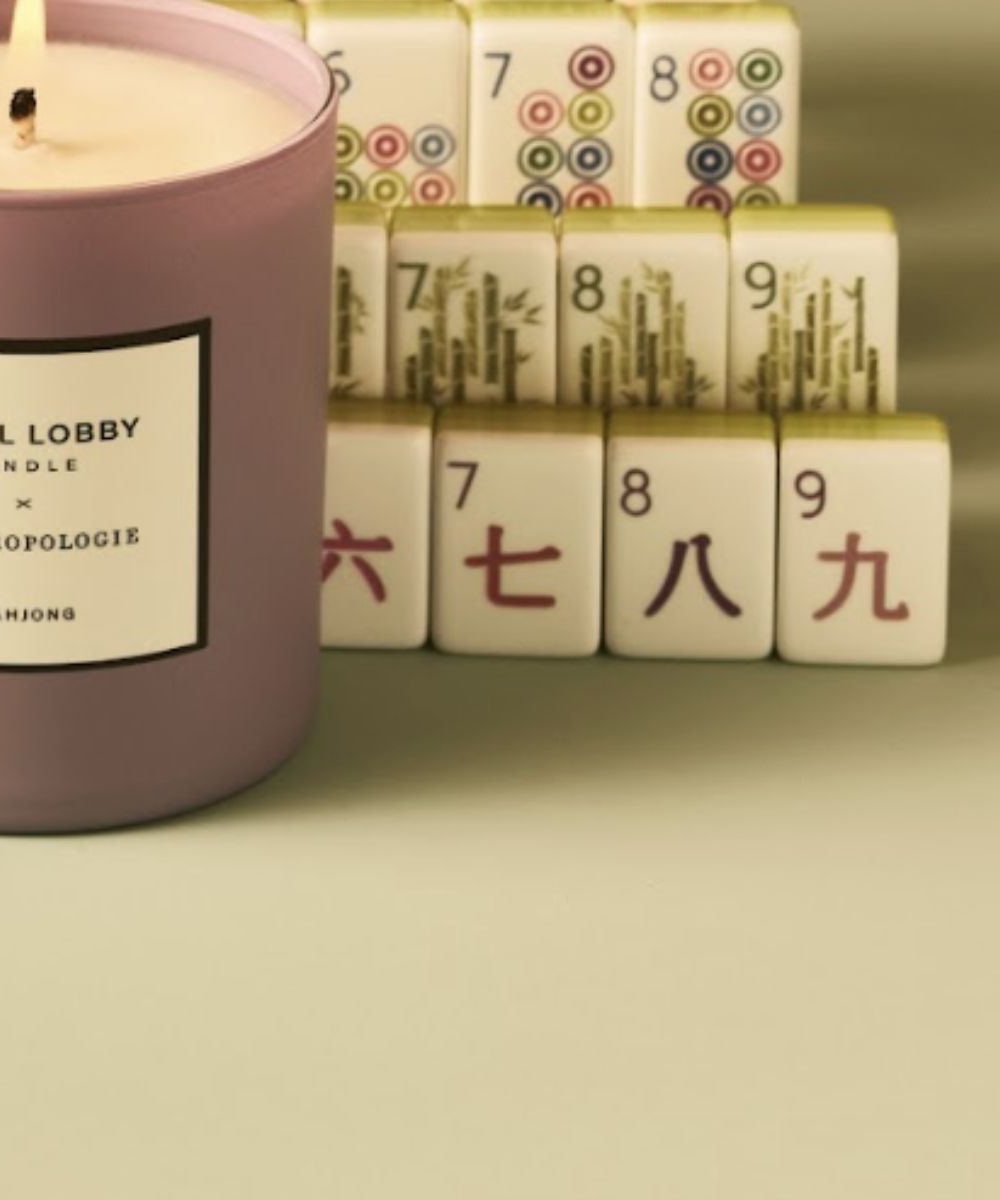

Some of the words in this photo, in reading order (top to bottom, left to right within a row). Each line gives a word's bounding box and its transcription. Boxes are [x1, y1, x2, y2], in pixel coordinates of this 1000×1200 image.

[484, 54, 513, 99] 7
[650, 56, 679, 102] 8
[396, 263, 429, 309] 7
[571, 264, 605, 313] 8
[744, 262, 778, 309] 9
[28, 417, 140, 445] LOBBY
[446, 461, 479, 509] 7
[619, 468, 652, 516] 8
[794, 470, 827, 518] 9
[321, 518, 394, 603] 六
[464, 524, 562, 608] 七
[644, 533, 742, 618] 八
[812, 532, 910, 621] 九
